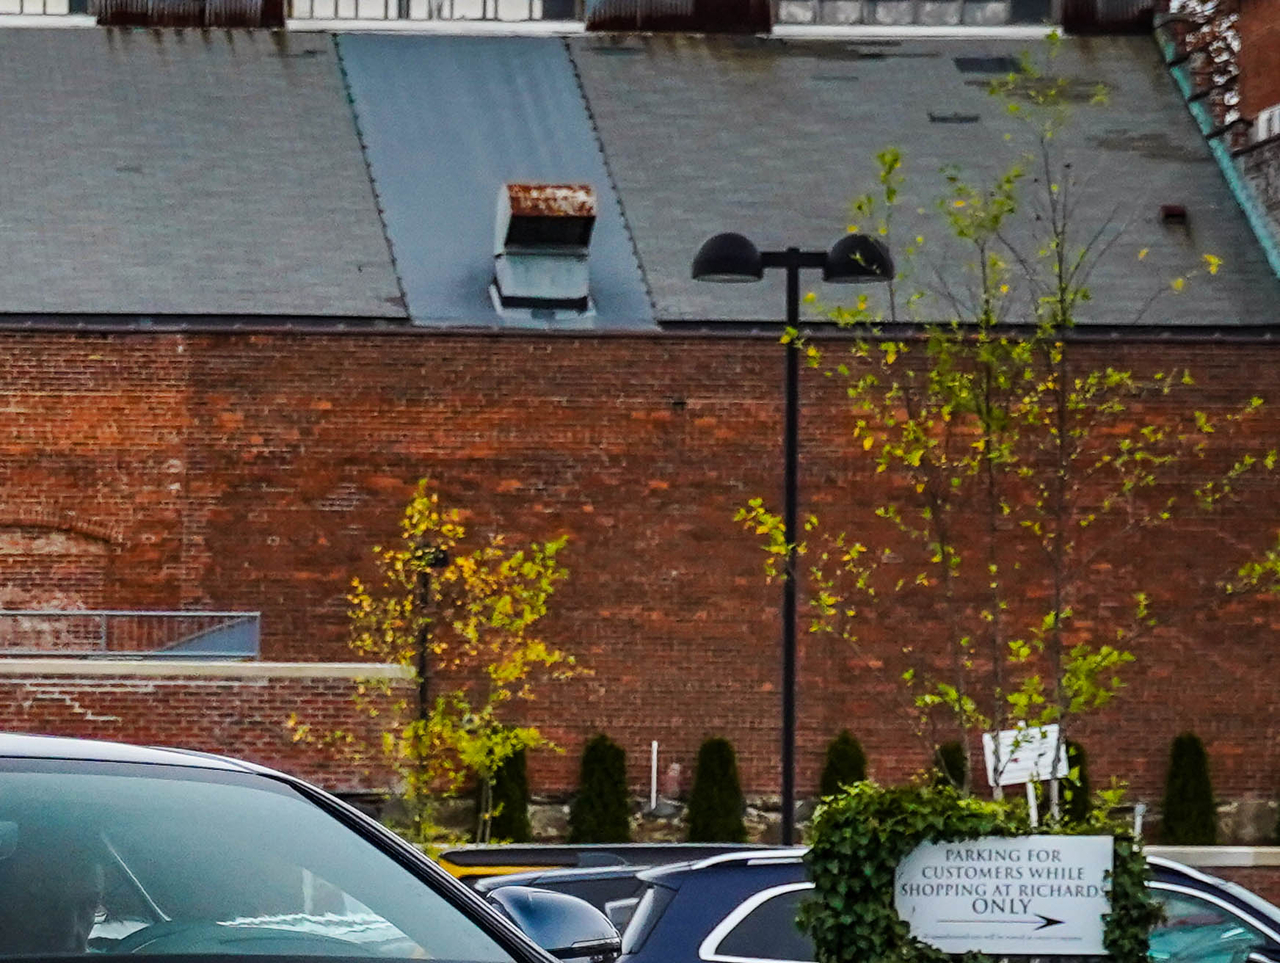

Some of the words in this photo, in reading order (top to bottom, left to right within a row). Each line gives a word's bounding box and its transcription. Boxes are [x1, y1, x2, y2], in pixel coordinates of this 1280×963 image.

[945, 849, 1021, 863] PARKING
[1027, 849, 1062, 863] FOR
[922, 866, 1023, 880] CUSTOMERS
[1029, 867, 1085, 880] WHILE
[900, 883, 987, 898] SHOPPING
[992, 884, 1012, 897] AT
[1019, 884, 1107, 898] RICHARDS
[972, 899, 1032, 915] ONLY
